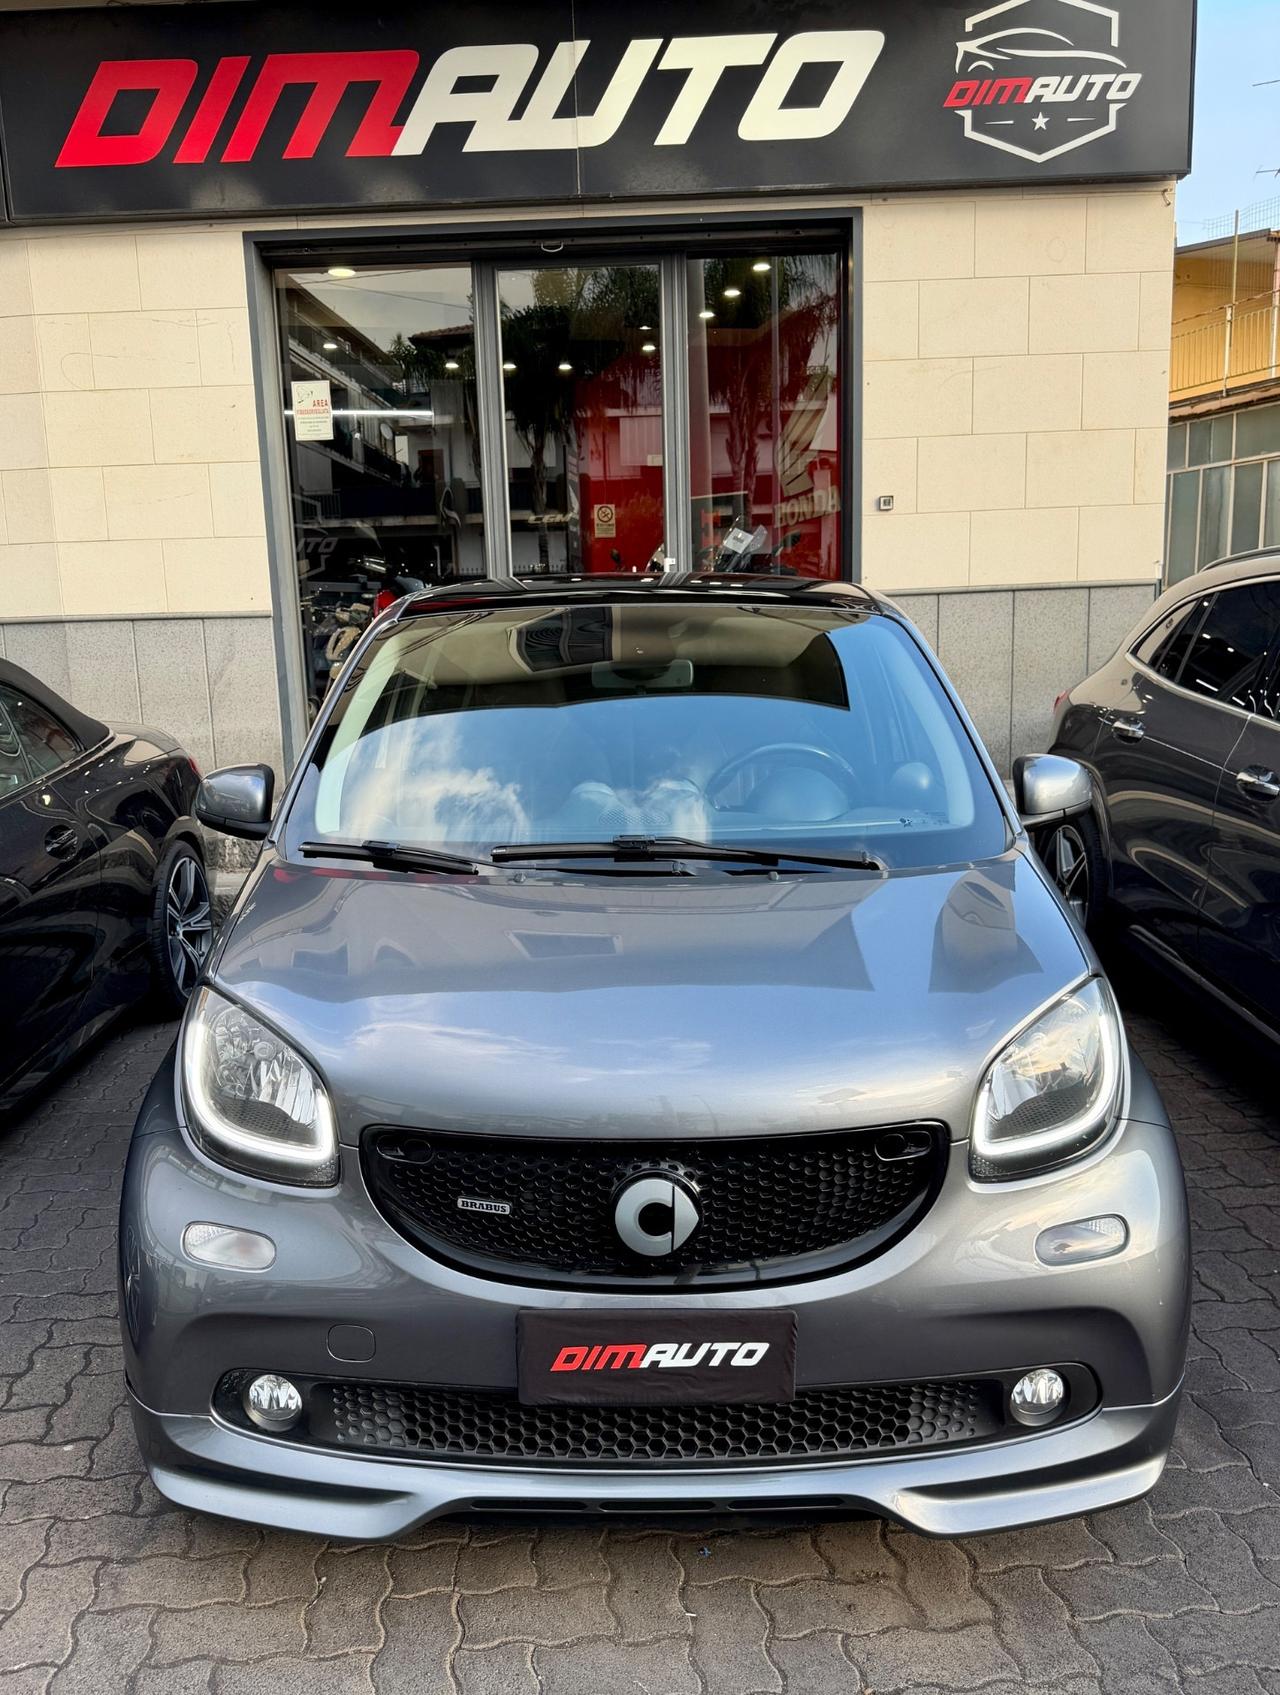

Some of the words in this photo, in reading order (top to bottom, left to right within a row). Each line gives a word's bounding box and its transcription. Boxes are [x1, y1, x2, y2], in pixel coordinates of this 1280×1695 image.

[54, 29, 886, 168] DIMAUTO
[943, 73, 1143, 108] DIMAUTO
[312, 399, 329, 408] AREA
[774, 485, 841, 529] HONDA
[461, 1200, 507, 1213] BRABUS
[550, 1343, 770, 1372] DIMAUTO
